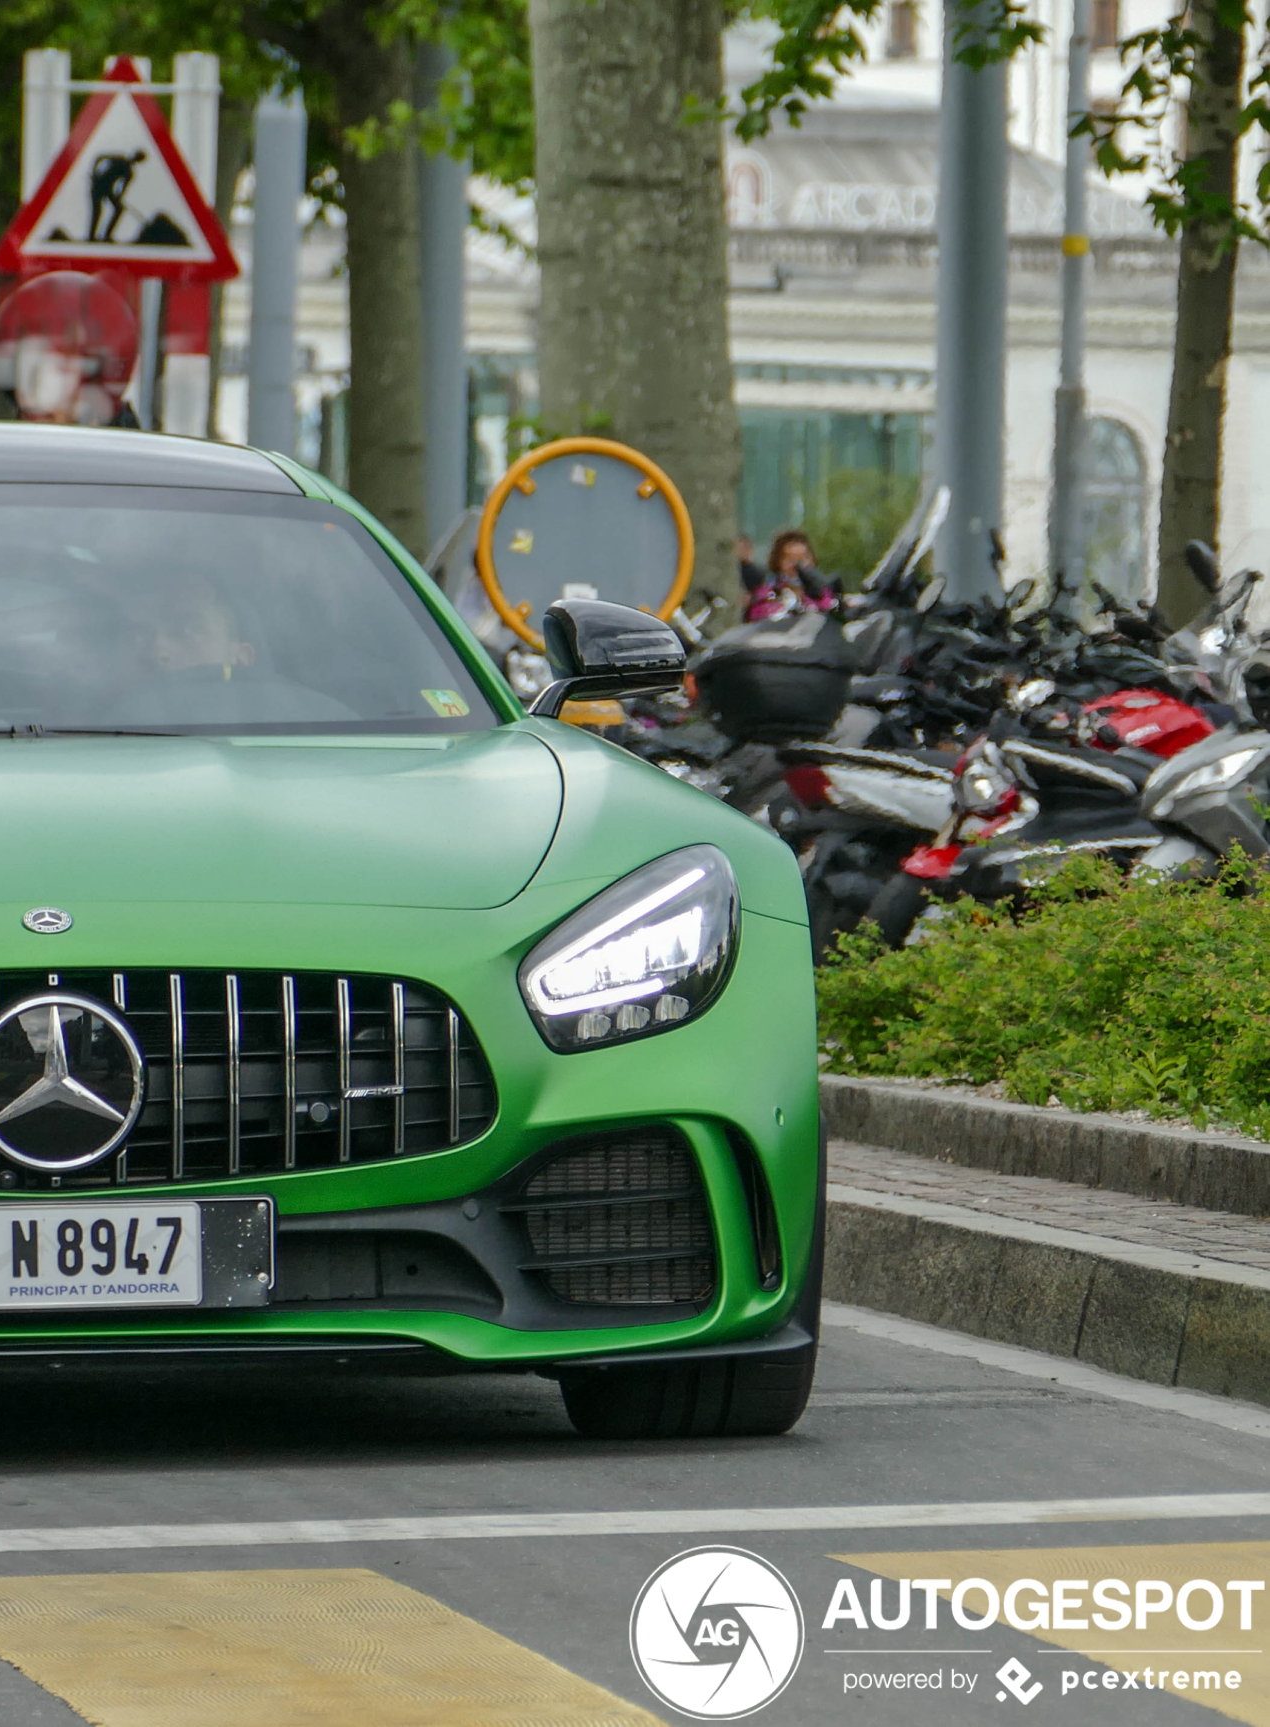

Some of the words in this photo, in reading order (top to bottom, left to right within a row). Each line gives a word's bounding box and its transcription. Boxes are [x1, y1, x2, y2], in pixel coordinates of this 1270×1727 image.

[790, 183, 937, 227] ARCAD
[12, 1219, 38, 1278] N
[57, 1217, 182, 1276] 8947
[9, 1284, 89, 1297] PRINCIPAT
[92, 1282, 180, 1296] D'ANDORRA
